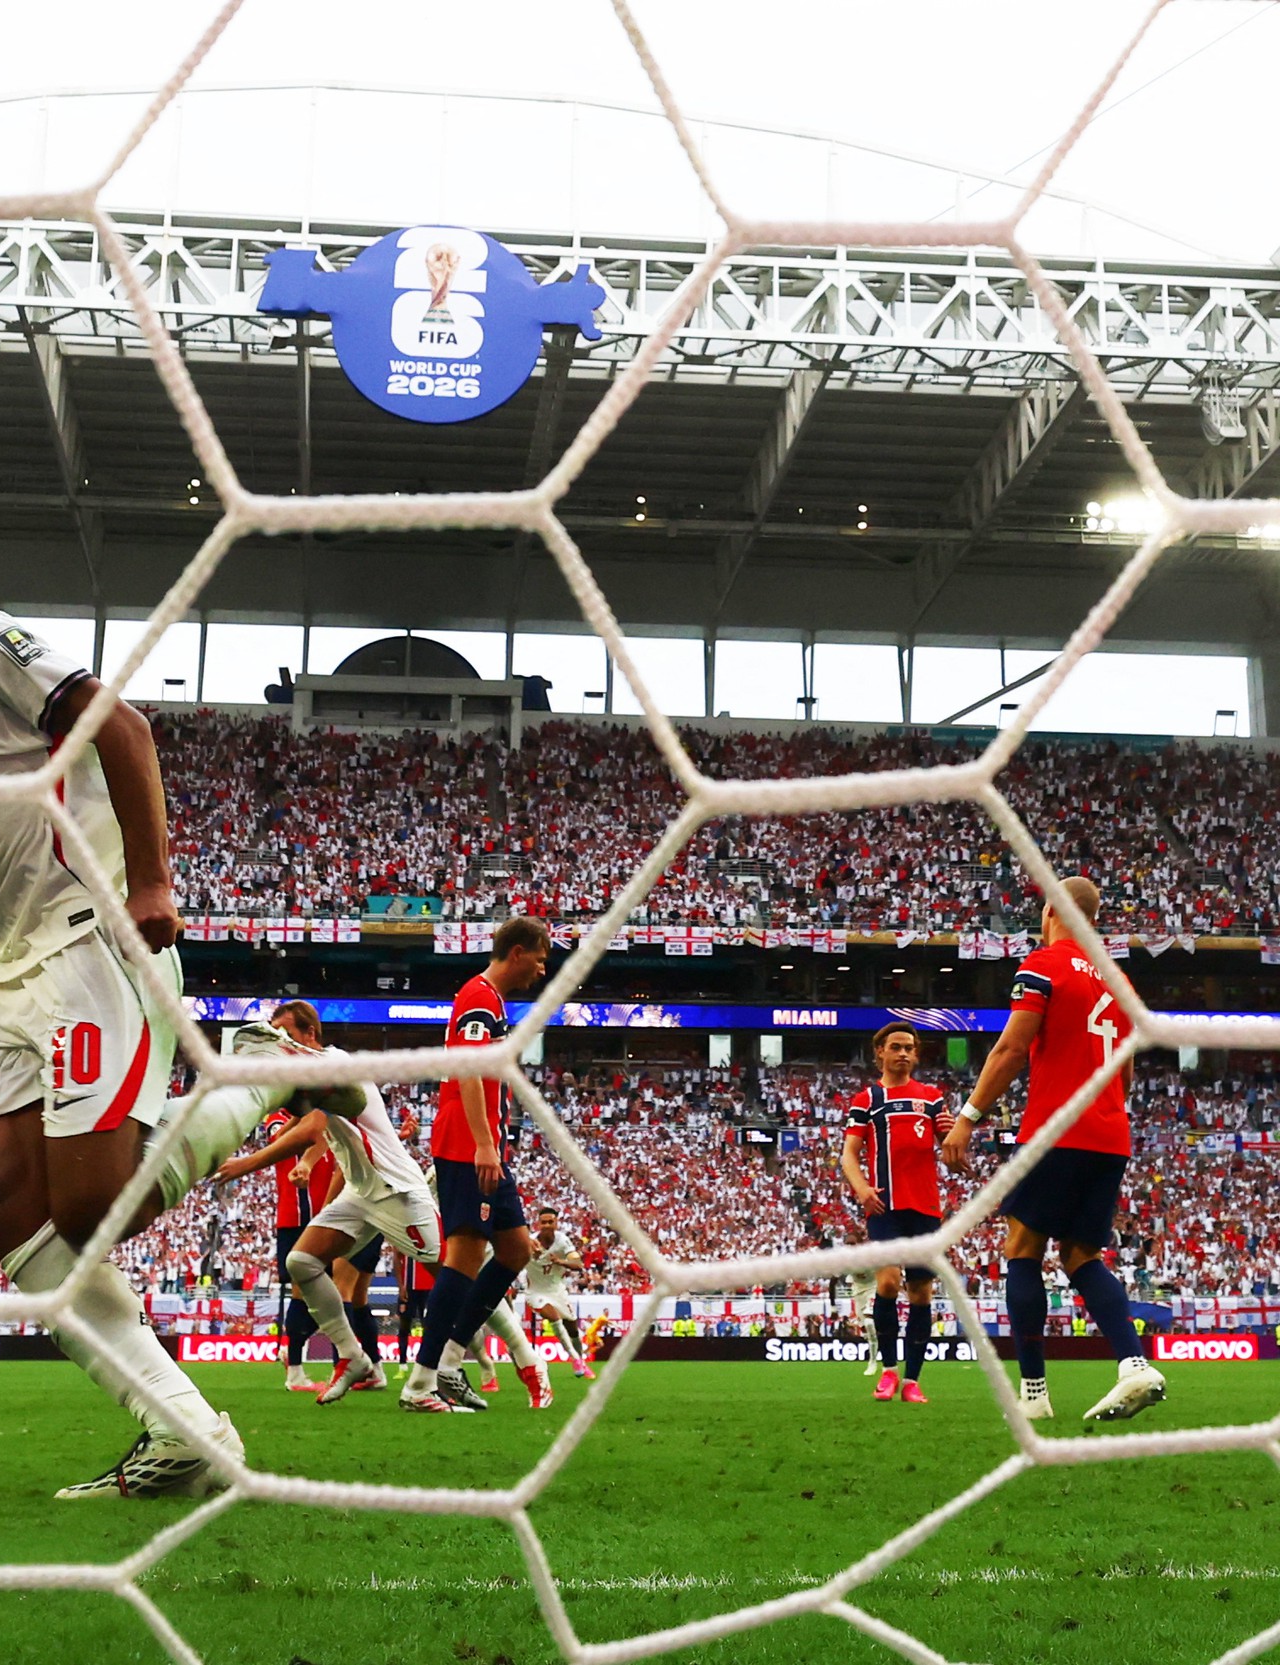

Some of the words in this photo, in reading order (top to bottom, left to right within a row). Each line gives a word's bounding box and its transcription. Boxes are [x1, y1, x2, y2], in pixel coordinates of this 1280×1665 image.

[418, 330, 459, 346] FIFA
[389, 359, 449, 376] WORLD
[449, 360, 482, 377] CUP
[387, 374, 481, 399] 2026
[773, 1009, 838, 1027] MIAMI
[1087, 991, 1118, 1067] 4
[765, 1339, 869, 1361] Smarter
[955, 1340, 979, 1361] al
[1157, 1337, 1254, 1360] Lenovo
